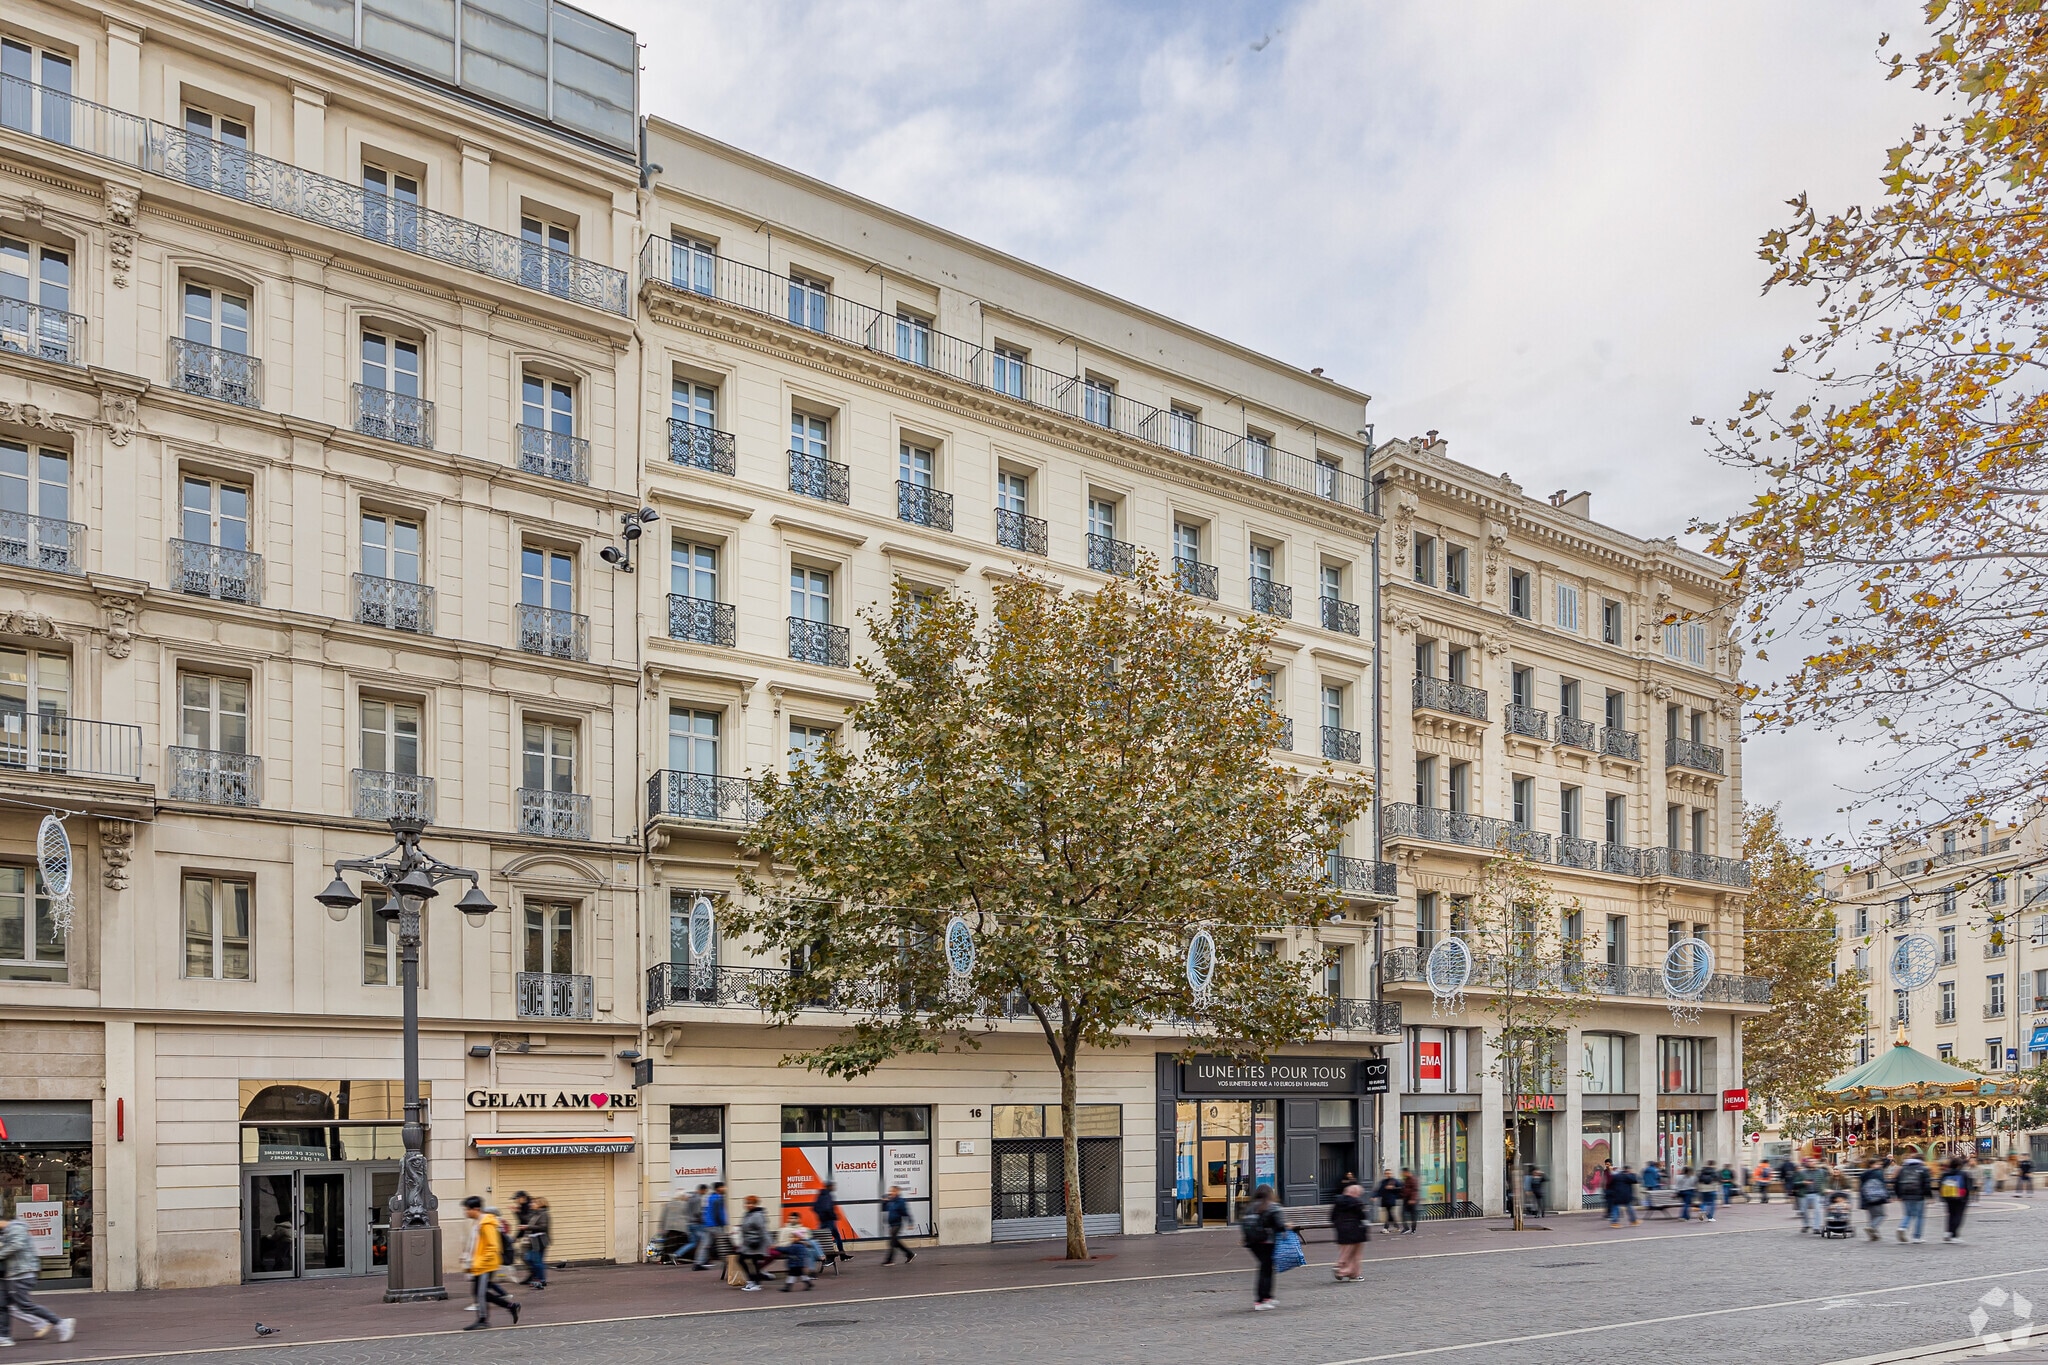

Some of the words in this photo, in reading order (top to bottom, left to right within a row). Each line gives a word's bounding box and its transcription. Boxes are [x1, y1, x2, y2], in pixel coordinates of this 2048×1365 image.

[1420, 1056, 1441, 1066] EMA
[1198, 1065, 1265, 1078] LUNETTES
[1271, 1066, 1308, 1079] POUR
[1312, 1067, 1346, 1080] TOUS
[467, 1090, 547, 1108] GELATI
[969, 1108, 982, 1118] 16
[508, 1147, 542, 1155] GLACES
[543, 1146, 588, 1154] ITALIENNES
[835, 1160, 877, 1170] viasanté
[675, 1166, 718, 1175] viasanté
